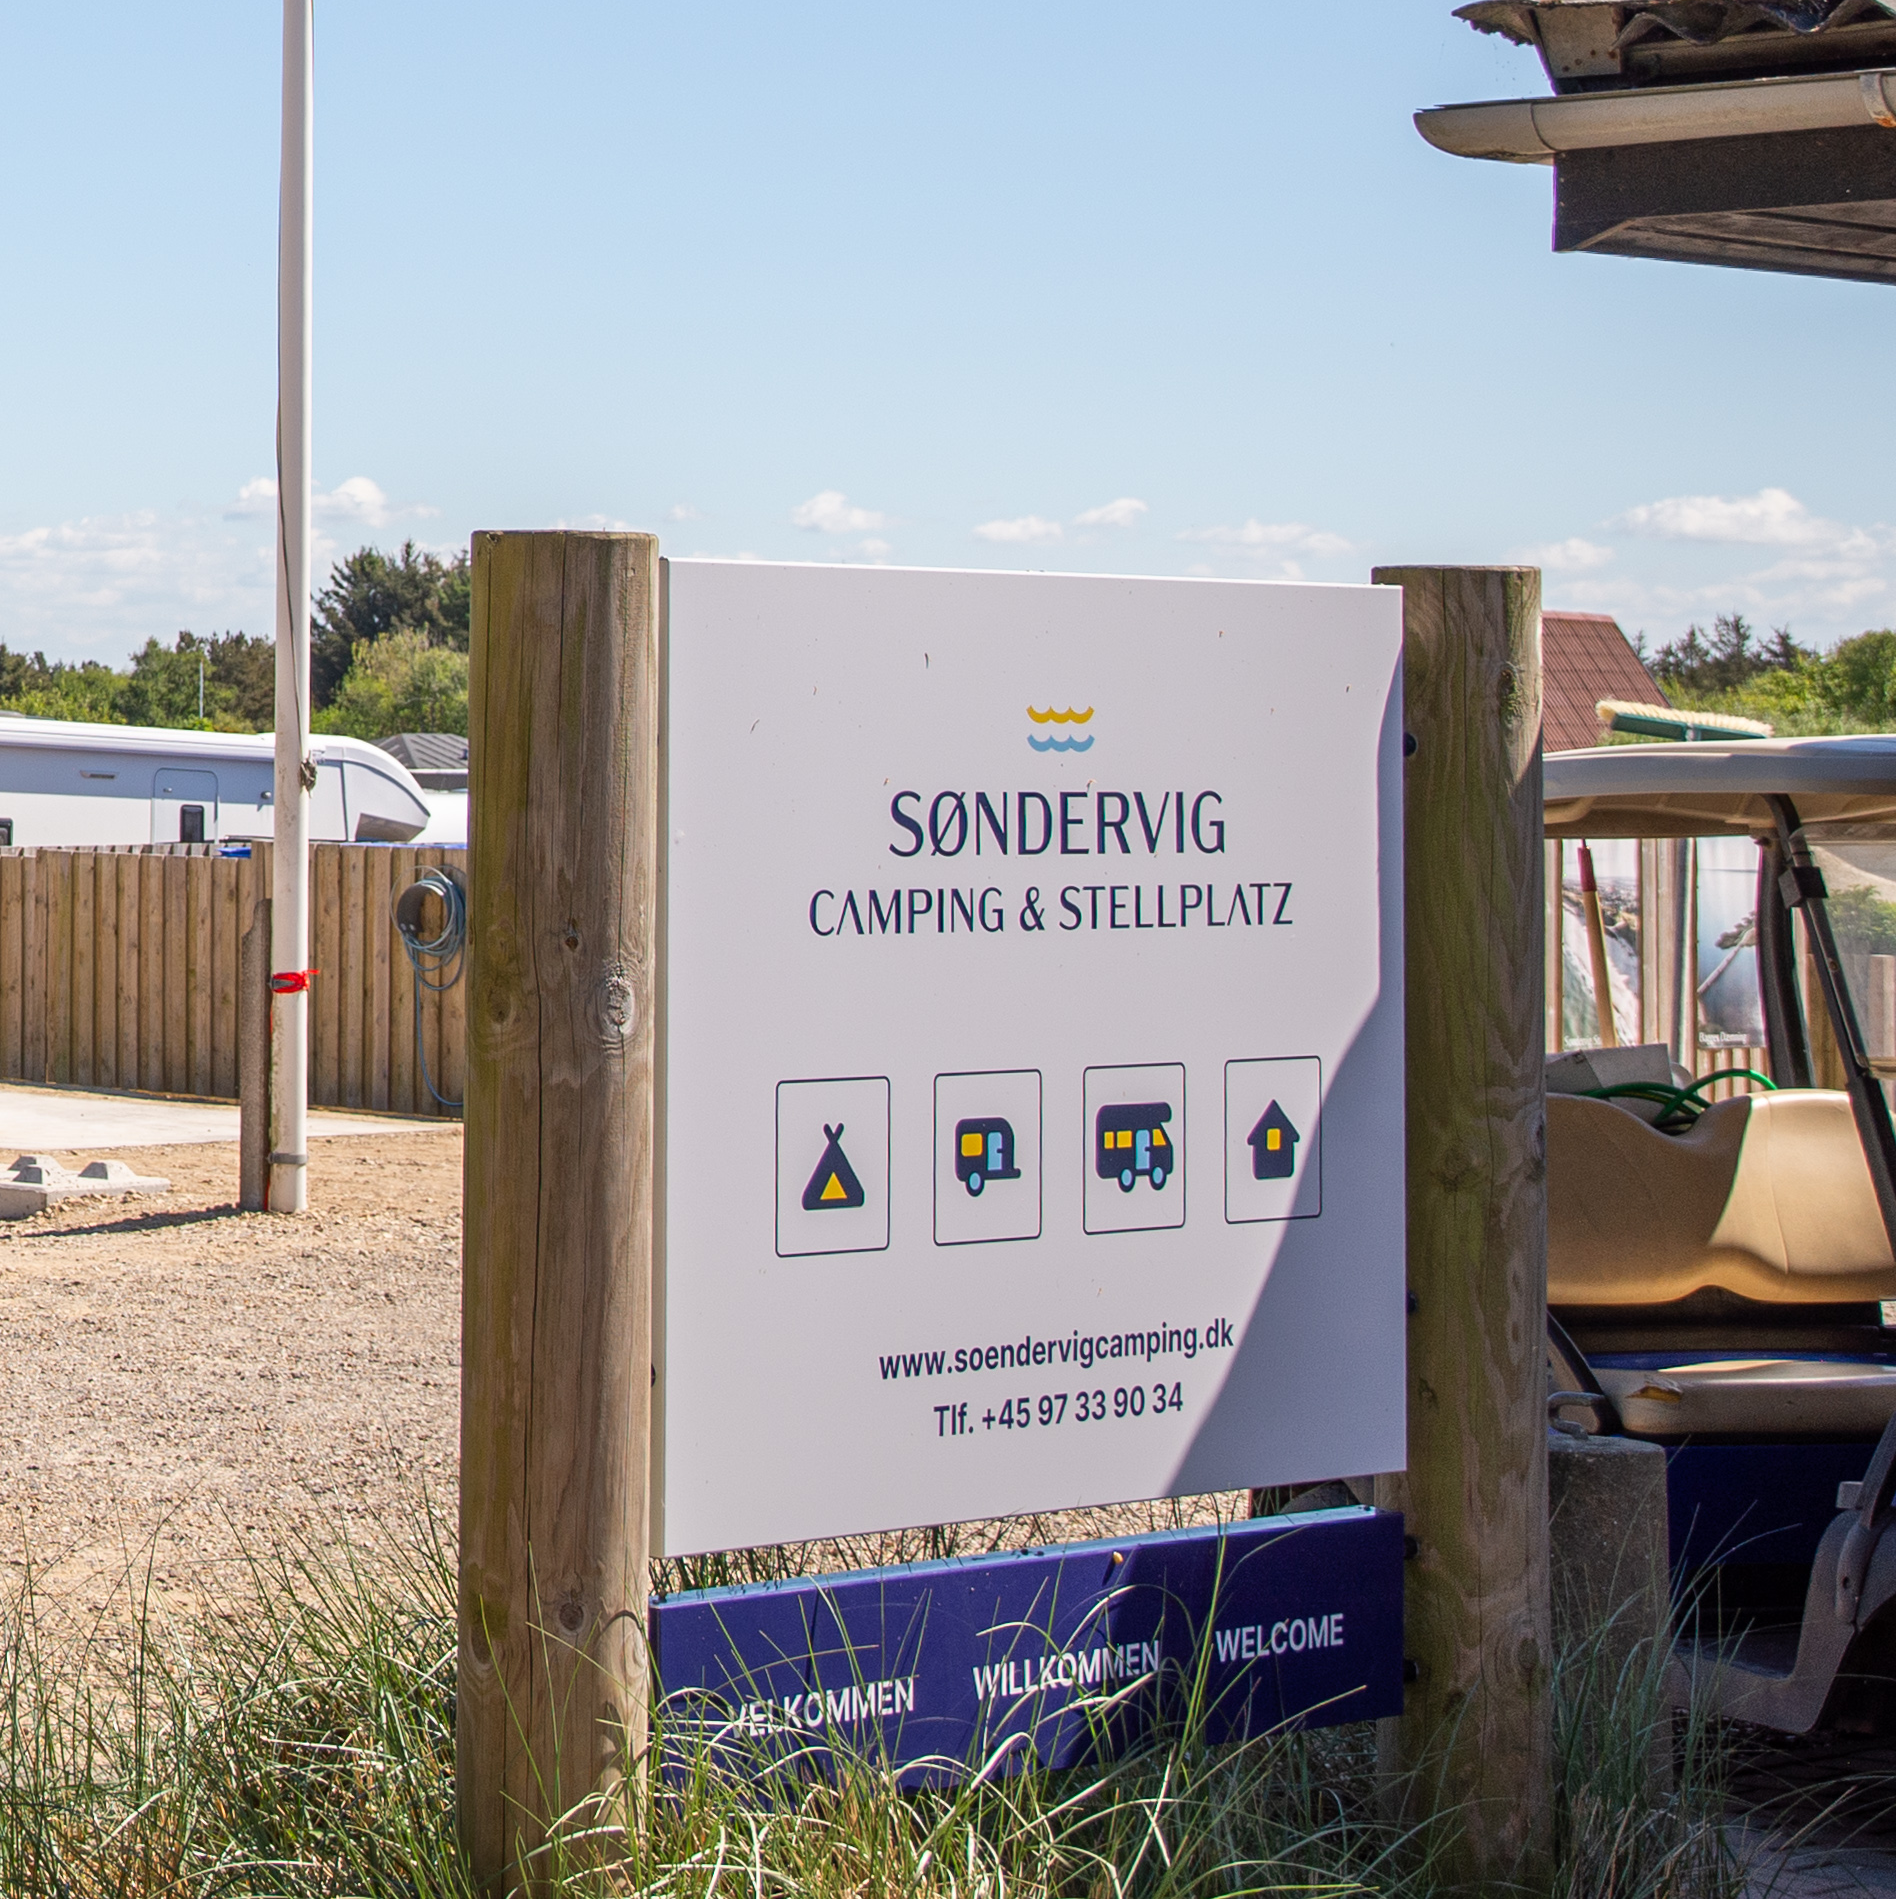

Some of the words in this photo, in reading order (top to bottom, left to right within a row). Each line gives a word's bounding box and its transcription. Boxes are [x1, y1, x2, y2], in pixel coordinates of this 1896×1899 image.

[889, 790, 1225, 857] SØNDERVIG
[809, 887, 1005, 936] CAMPING
[1019, 886, 1046, 932] &
[1059, 882, 1294, 931] STELLPLATZ
[879, 1318, 1235, 1379] www.soendervigcamping.dk
[933, 1402, 975, 1437] Tlf.
[982, 1397, 1031, 1430] +45
[1038, 1393, 1068, 1426] 97
[1075, 1389, 1107, 1422] 33
[1114, 1385, 1145, 1418] 90
[1152, 1381, 1184, 1413] 34
[973, 1640, 1160, 1700] WILLKOMMEN
[1216, 1613, 1345, 1663] WELCOME
